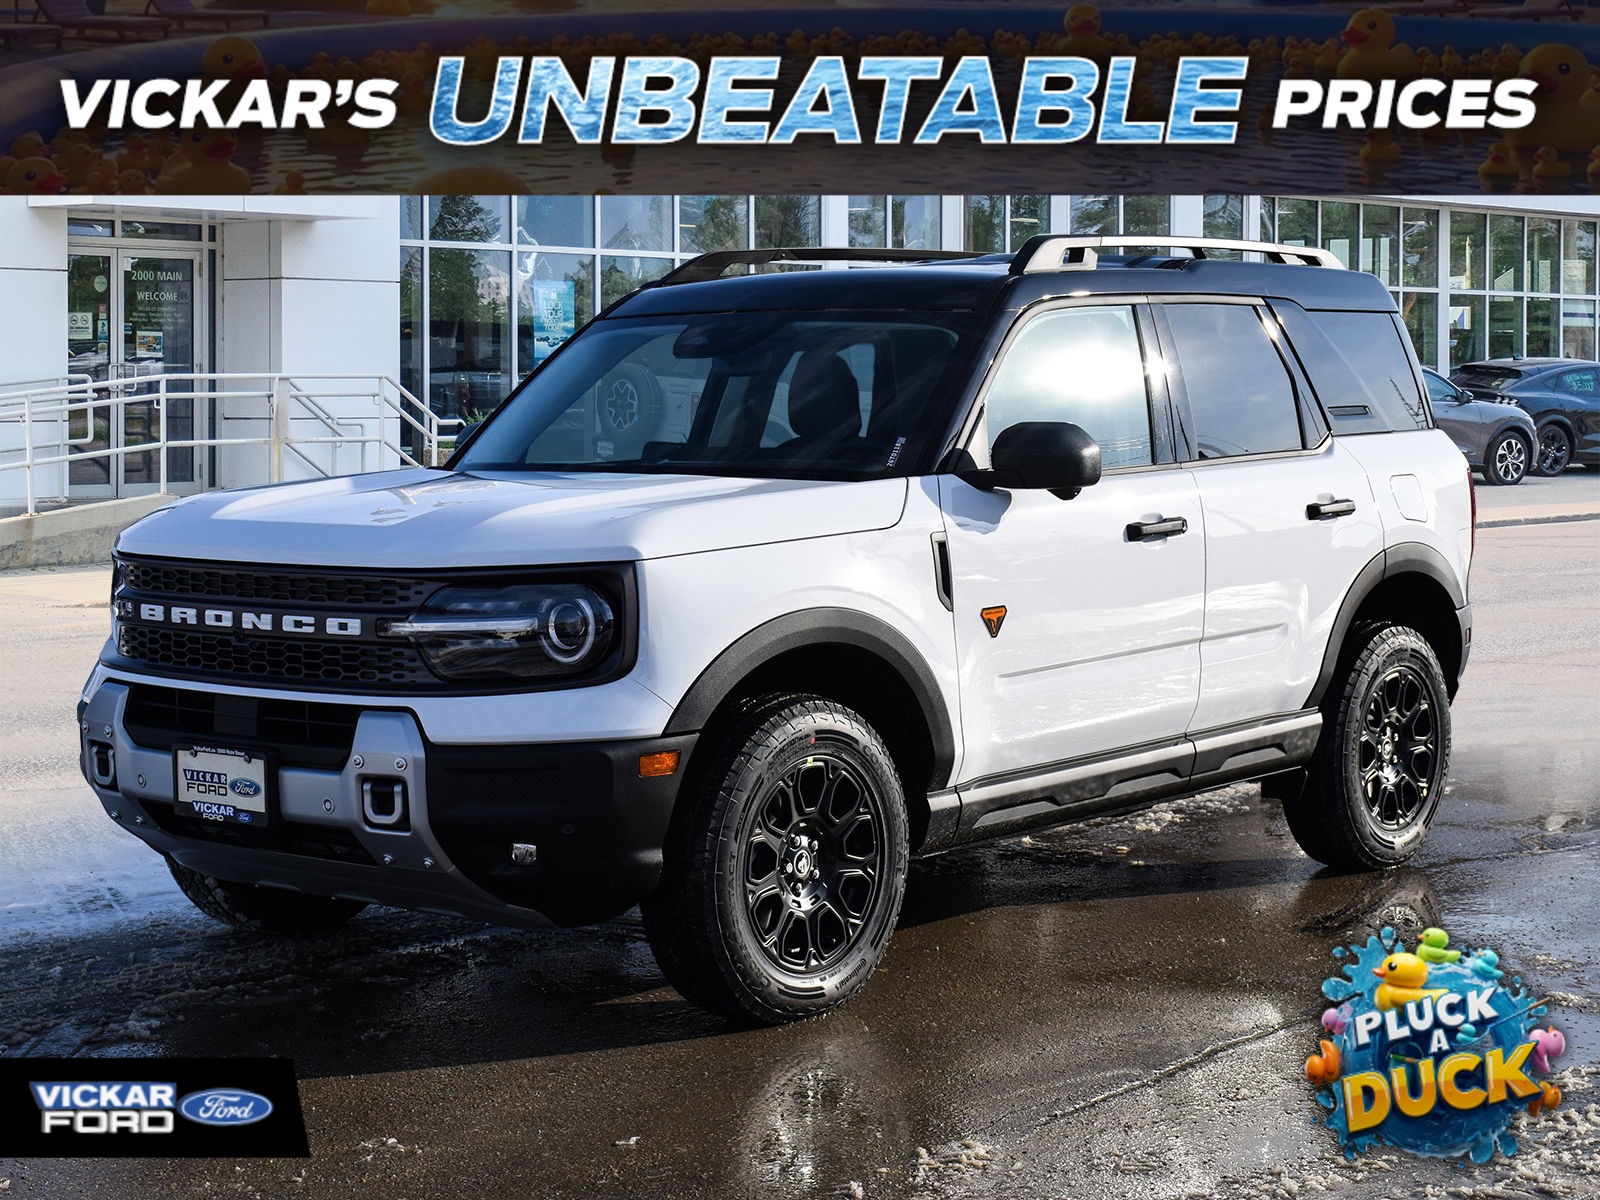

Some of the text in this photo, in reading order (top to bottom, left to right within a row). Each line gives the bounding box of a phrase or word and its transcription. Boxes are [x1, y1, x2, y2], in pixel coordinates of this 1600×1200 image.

[132, 270, 182, 281] 2000 MAIN
[136, 291, 178, 301] WELCOME
[543, 301, 564, 310] LOCK
[543, 309, 564, 318] YOUR
[140, 603, 362, 636] BRONCO
[185, 770, 227, 784] VICKAR
[187, 782, 227, 796] FORD
[234, 780, 256, 795] Ford
[193, 802, 234, 816] VICKAR
[203, 813, 224, 821] FORD
